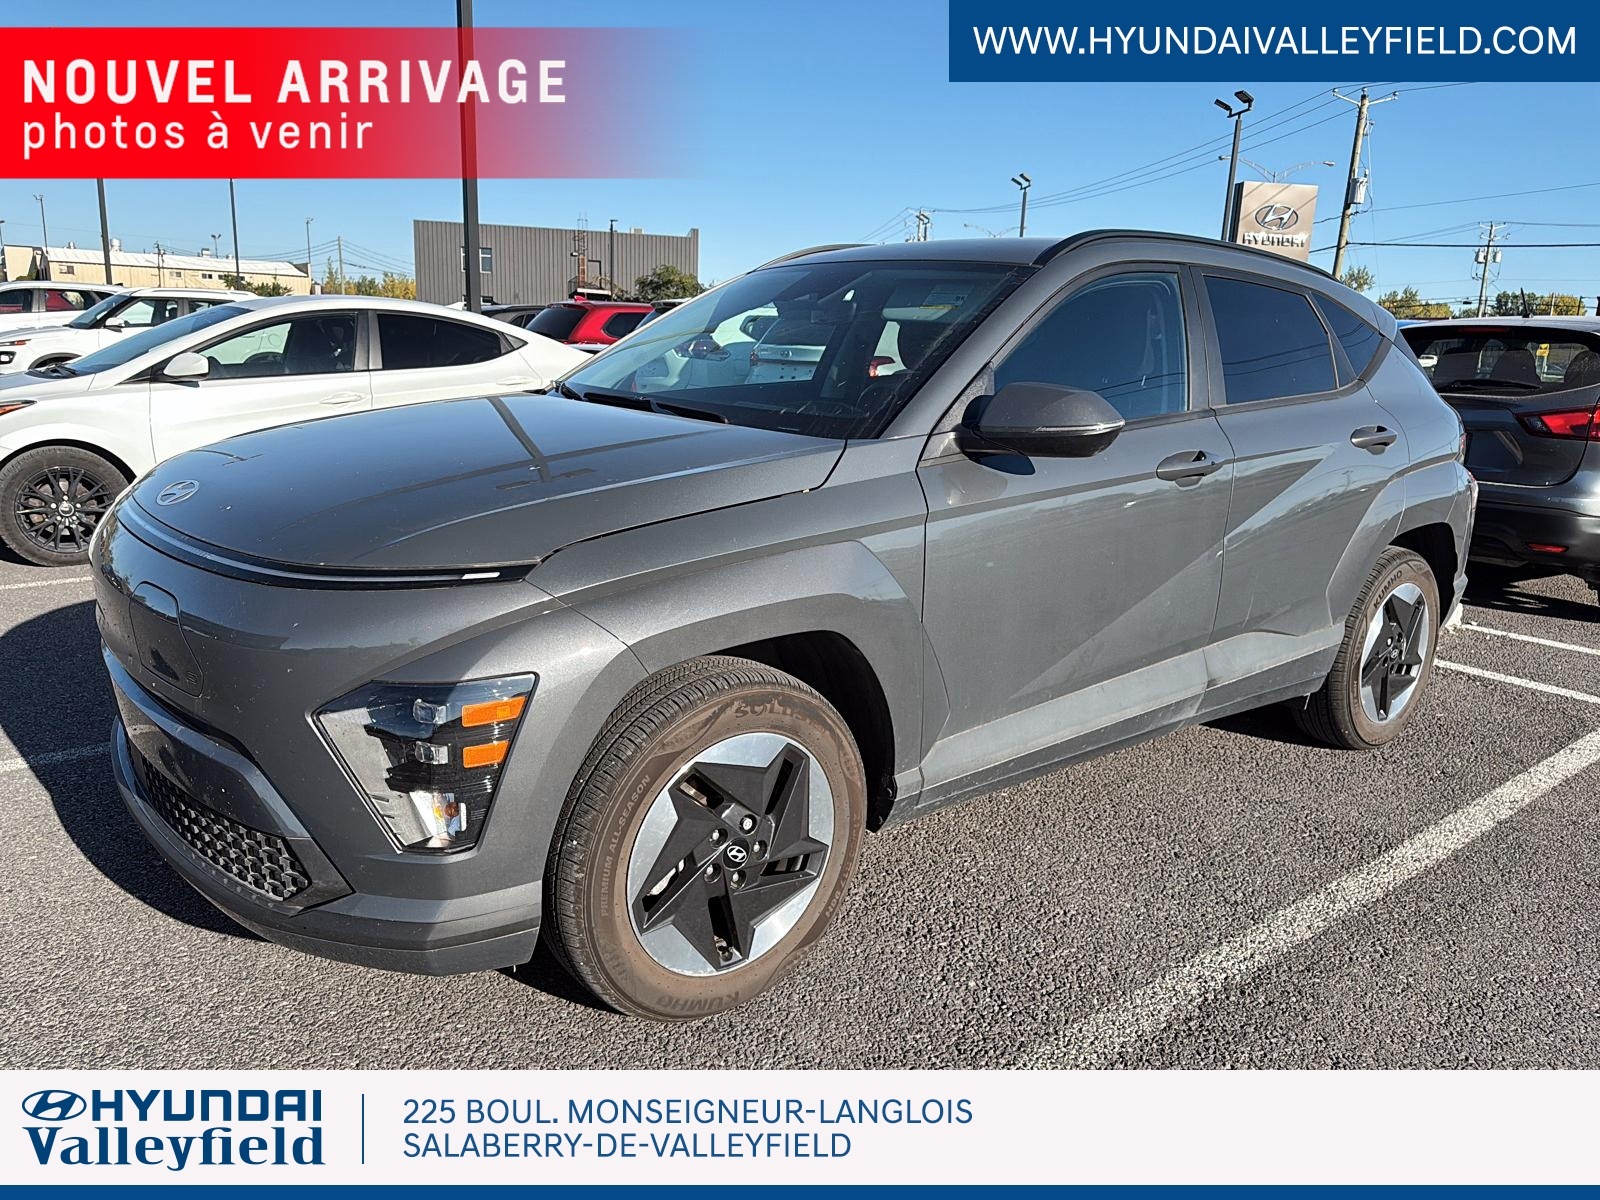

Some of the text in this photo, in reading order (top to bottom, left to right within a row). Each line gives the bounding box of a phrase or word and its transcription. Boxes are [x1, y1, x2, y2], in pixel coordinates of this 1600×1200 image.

[1242, 231, 1309, 248] HYUNDAI
[1373, 570, 1402, 609] KUMHO
[600, 774, 650, 917] PREMIUM ALL-SEASON
